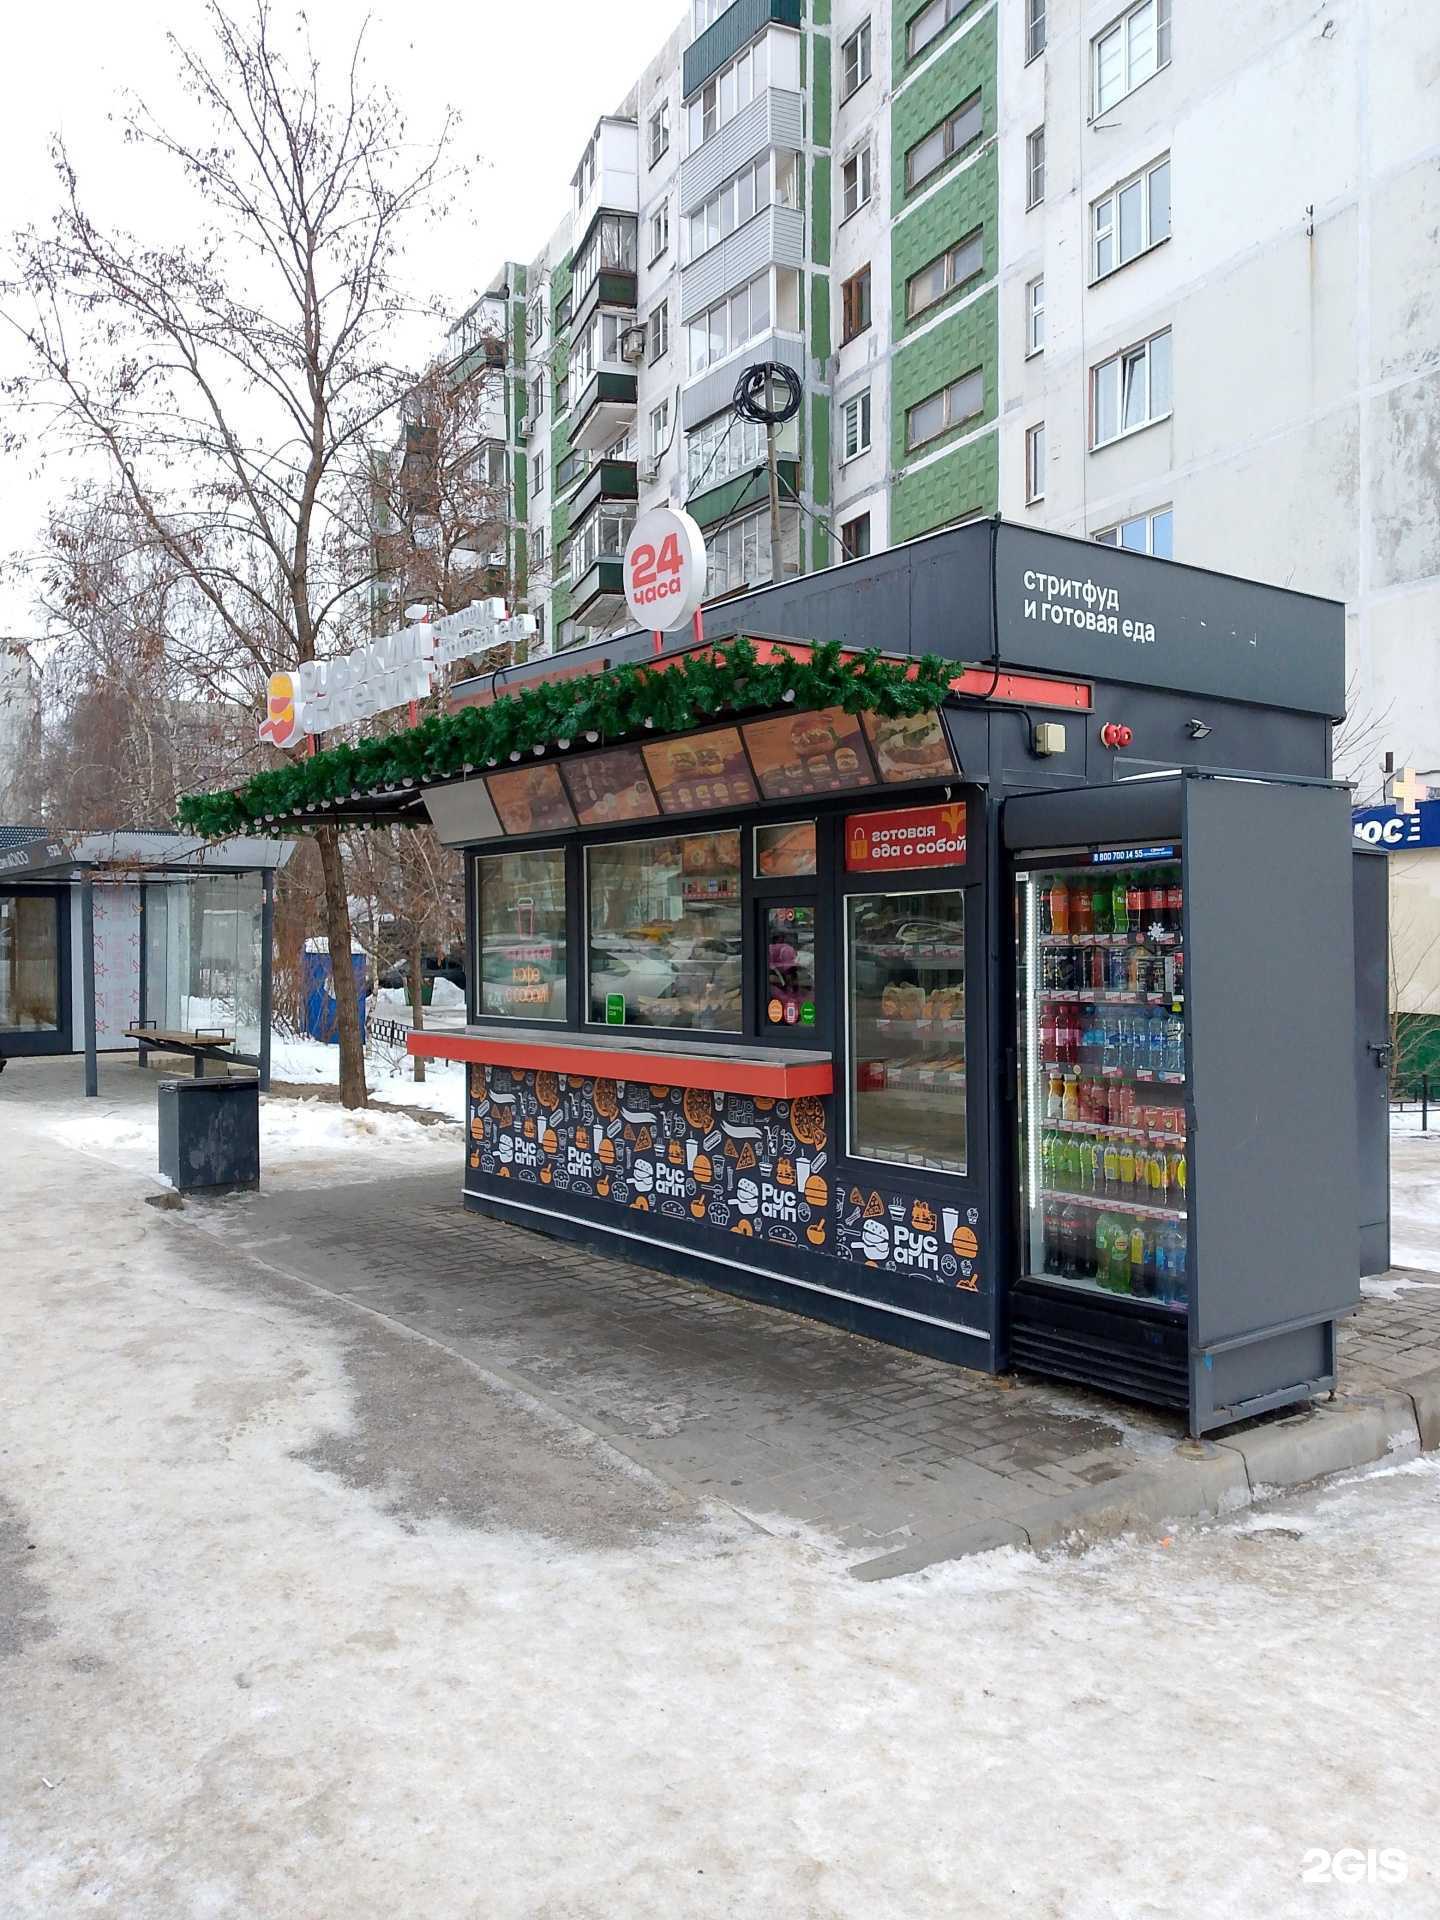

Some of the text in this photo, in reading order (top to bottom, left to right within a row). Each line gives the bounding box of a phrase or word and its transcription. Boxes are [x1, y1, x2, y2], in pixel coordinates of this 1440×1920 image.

[631, 533, 684, 589] 24
[634, 577, 681, 605] часа
[1023, 569, 1120, 611] стритфуд
[1024, 599, 1155, 644] и готовая еда
[872, 826, 936, 842] готовая
[872, 835, 967, 858] еда с собой
[1099, 852, 1112, 862] 800
[1112, 851, 1125, 860] 700
[1125, 850, 1133, 859] 14
[514, 1137, 537, 1156] Рус
[567, 1146, 592, 1166] Рус
[656, 1163, 686, 1184] Рус
[761, 1183, 797, 1209] Рус
[893, 1225, 938, 1255] Рус
